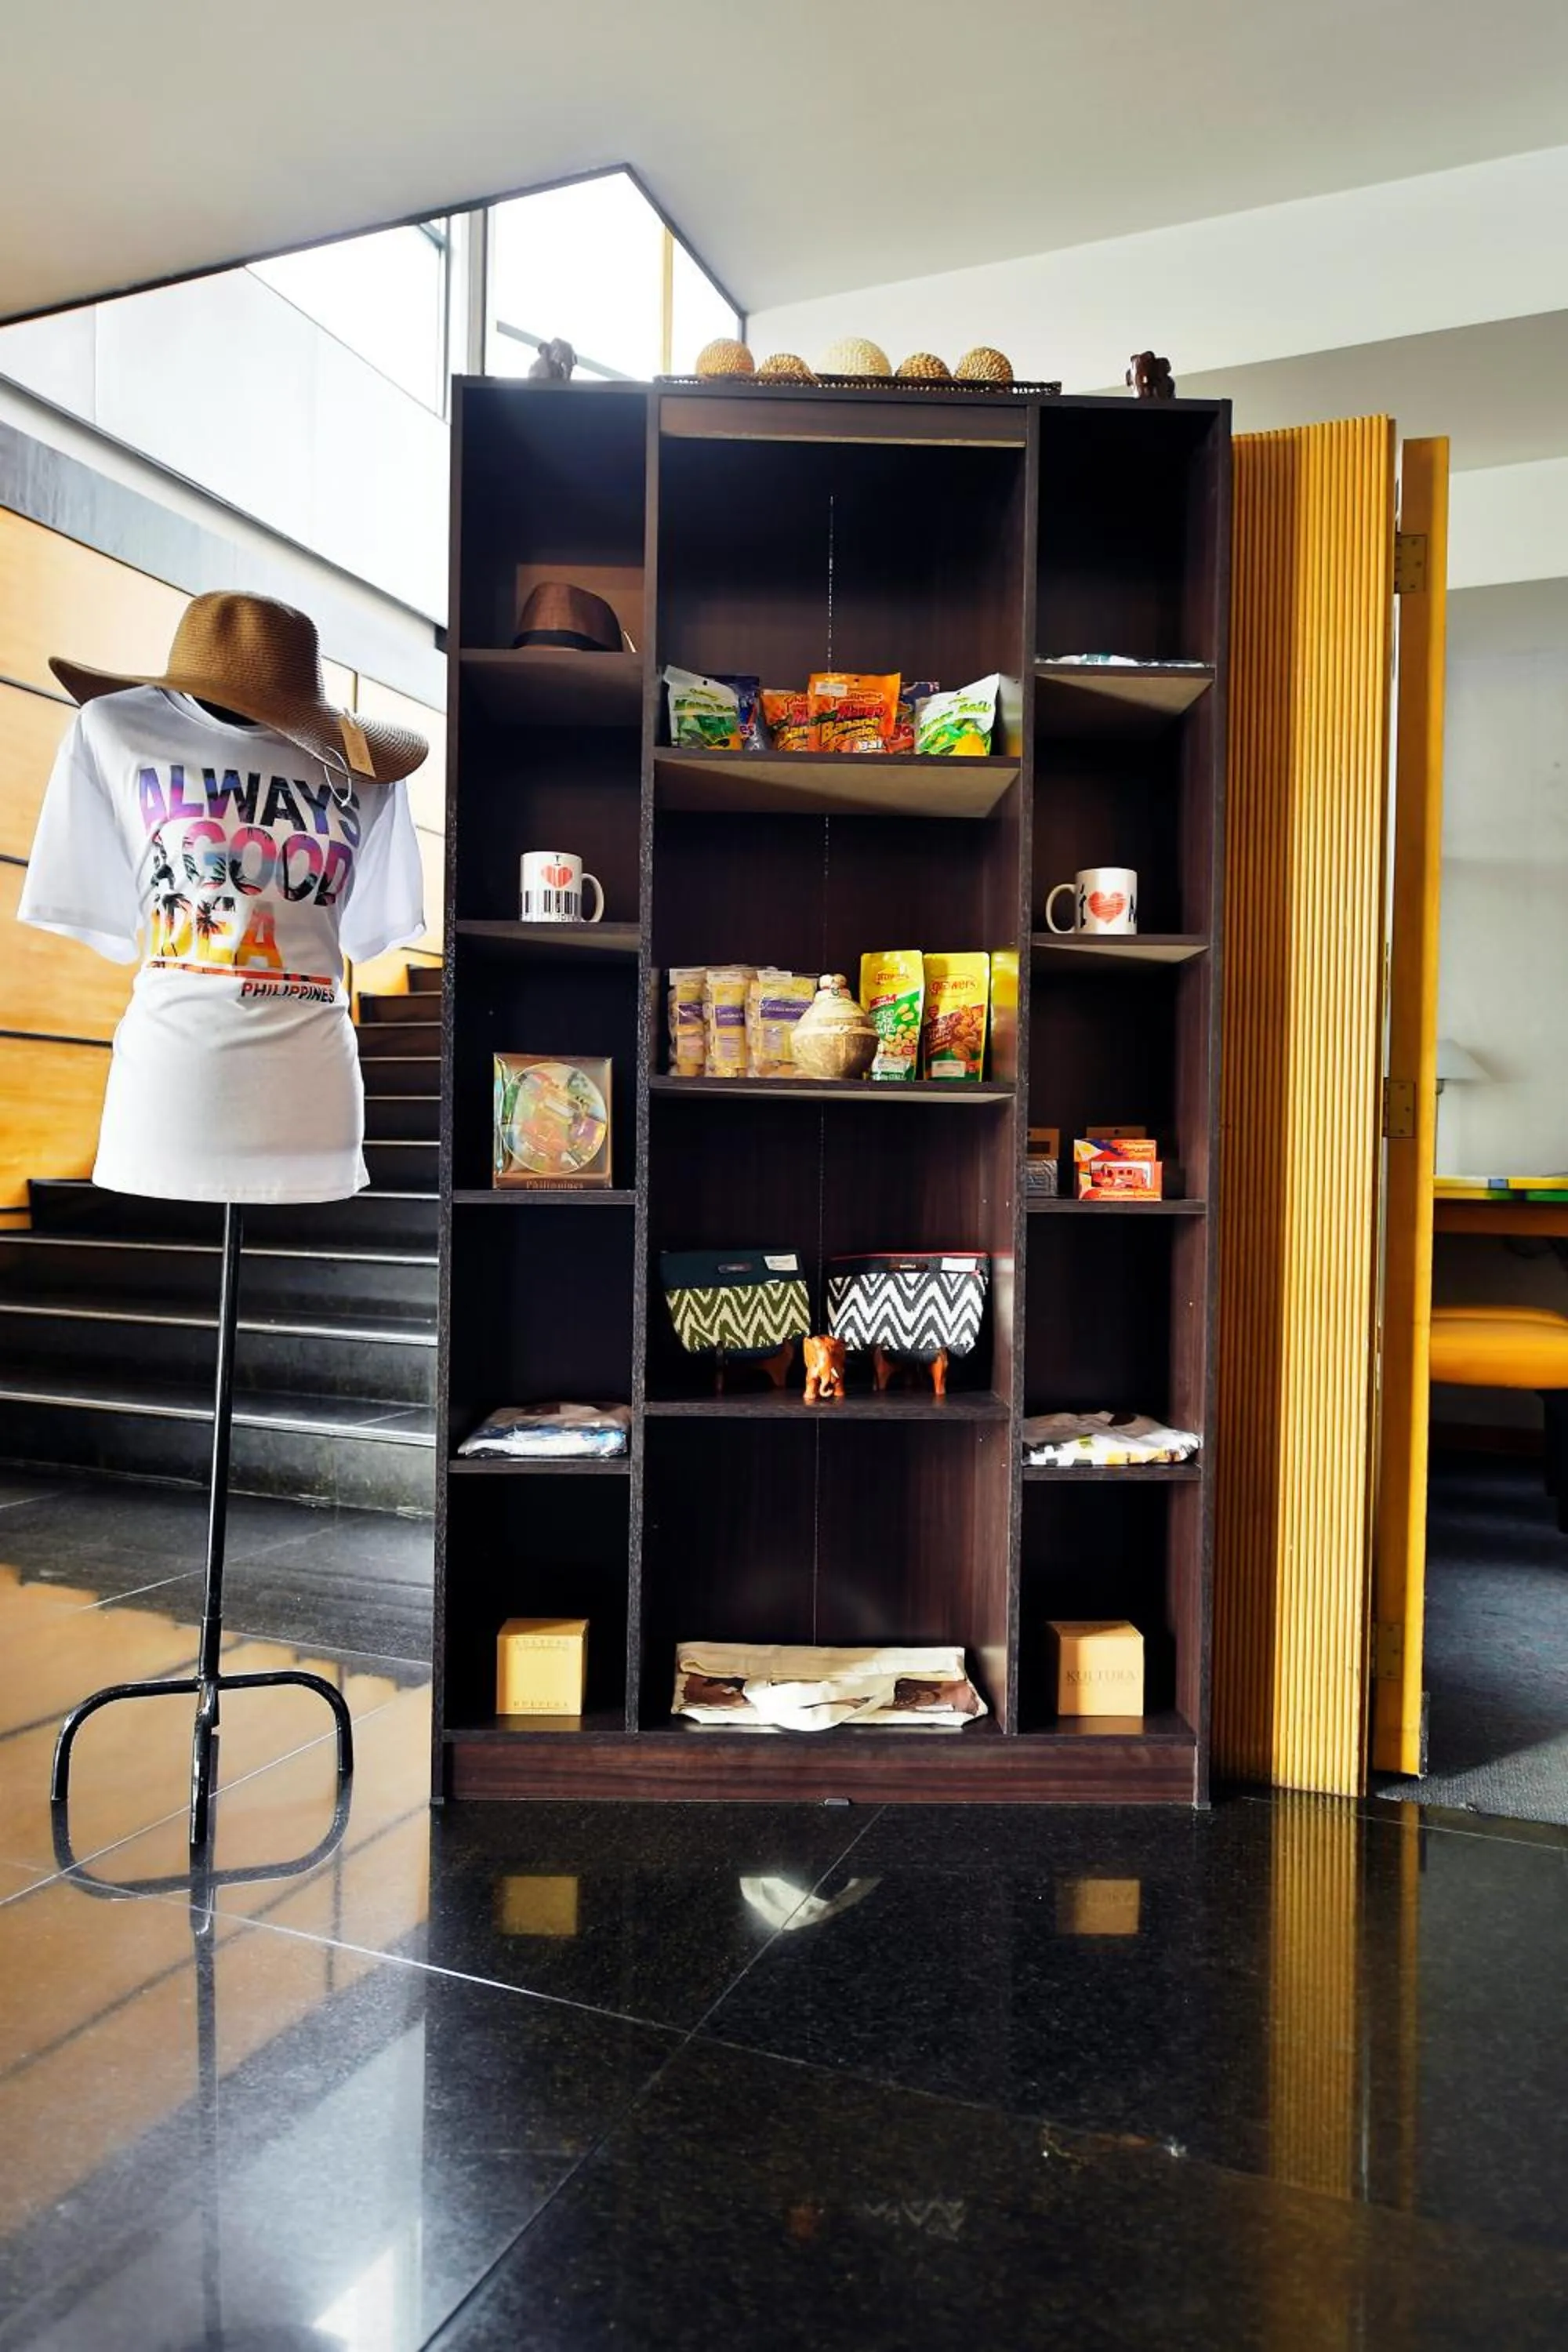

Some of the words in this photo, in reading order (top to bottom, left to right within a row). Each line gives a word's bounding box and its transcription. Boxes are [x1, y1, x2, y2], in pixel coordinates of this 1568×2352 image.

[138, 764, 361, 848] ALWAYS
[182, 820, 355, 906] GOOD
[149, 892, 285, 970] IDEA
[241, 982, 336, 1004] PHILIPPINES
